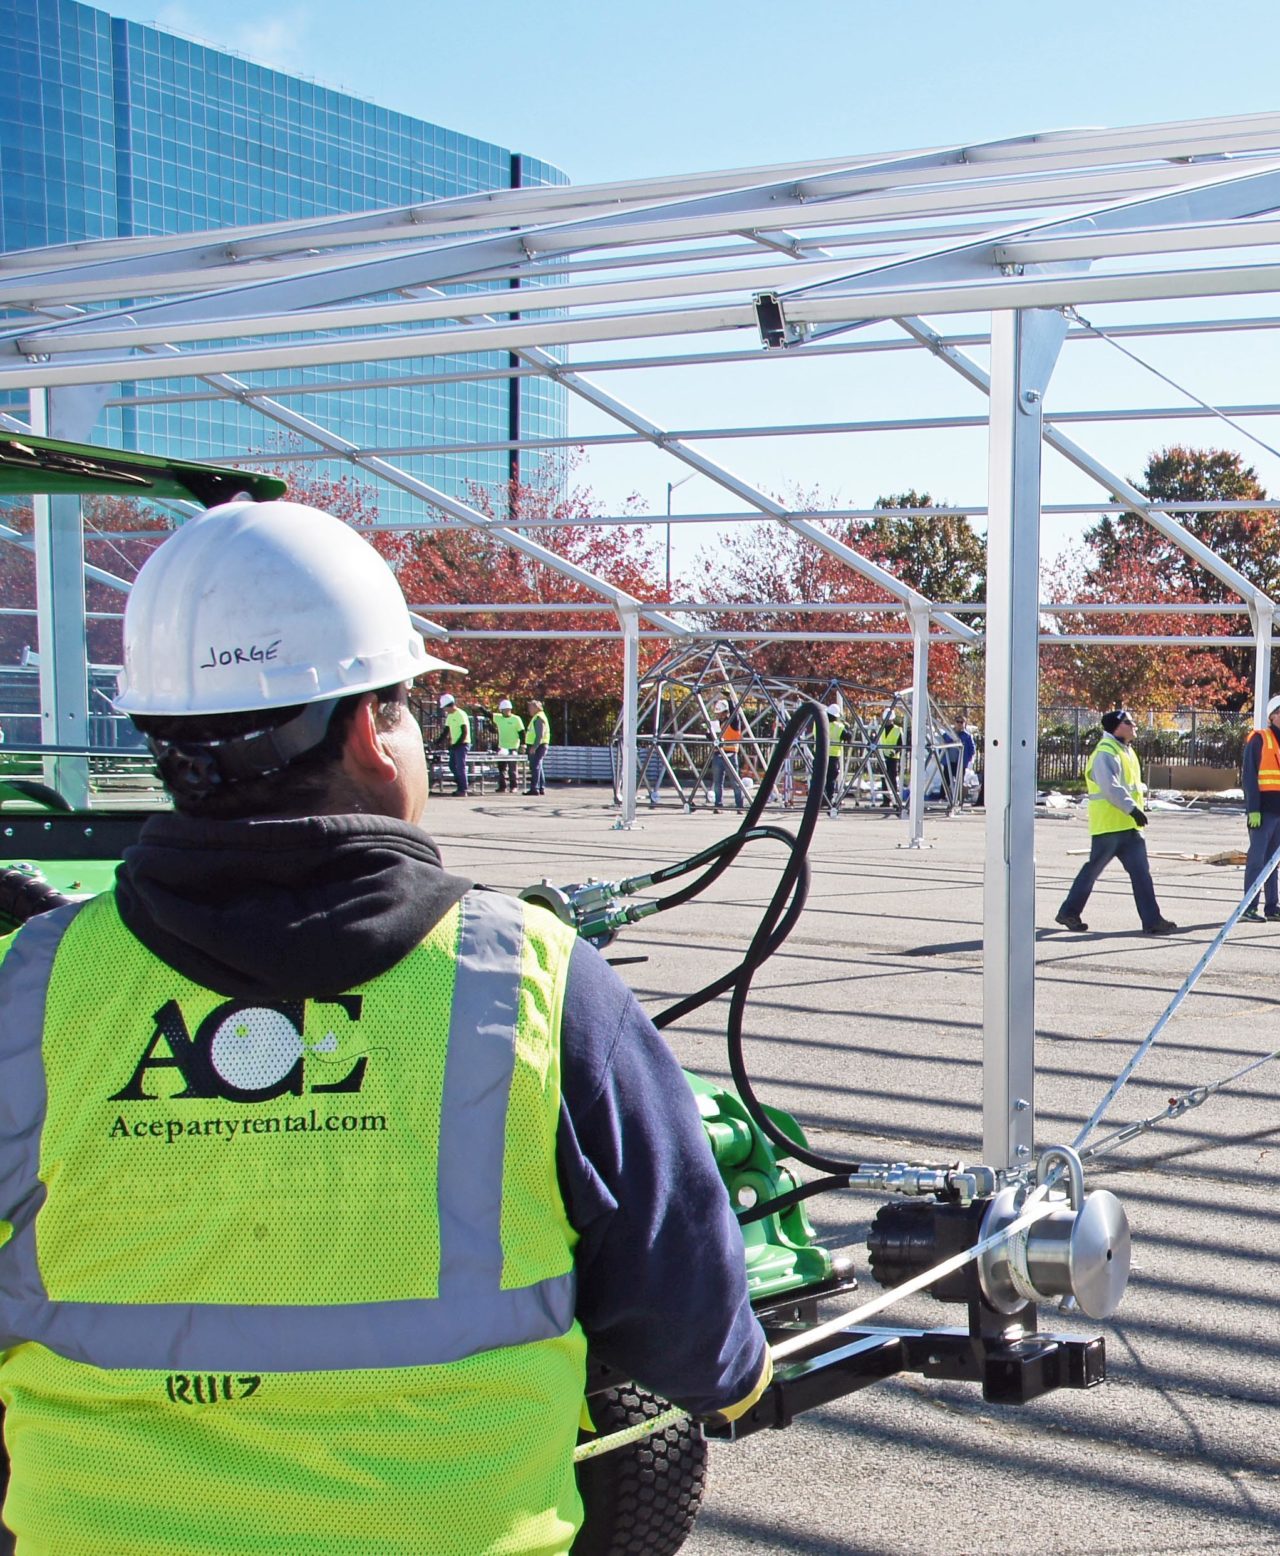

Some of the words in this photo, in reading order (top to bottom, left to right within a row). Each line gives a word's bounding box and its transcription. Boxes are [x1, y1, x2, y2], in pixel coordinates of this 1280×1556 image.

[200, 639, 282, 669] JORGE
[107, 994, 368, 1104] ACE
[109, 1109, 389, 1143] Acepartyrental.com
